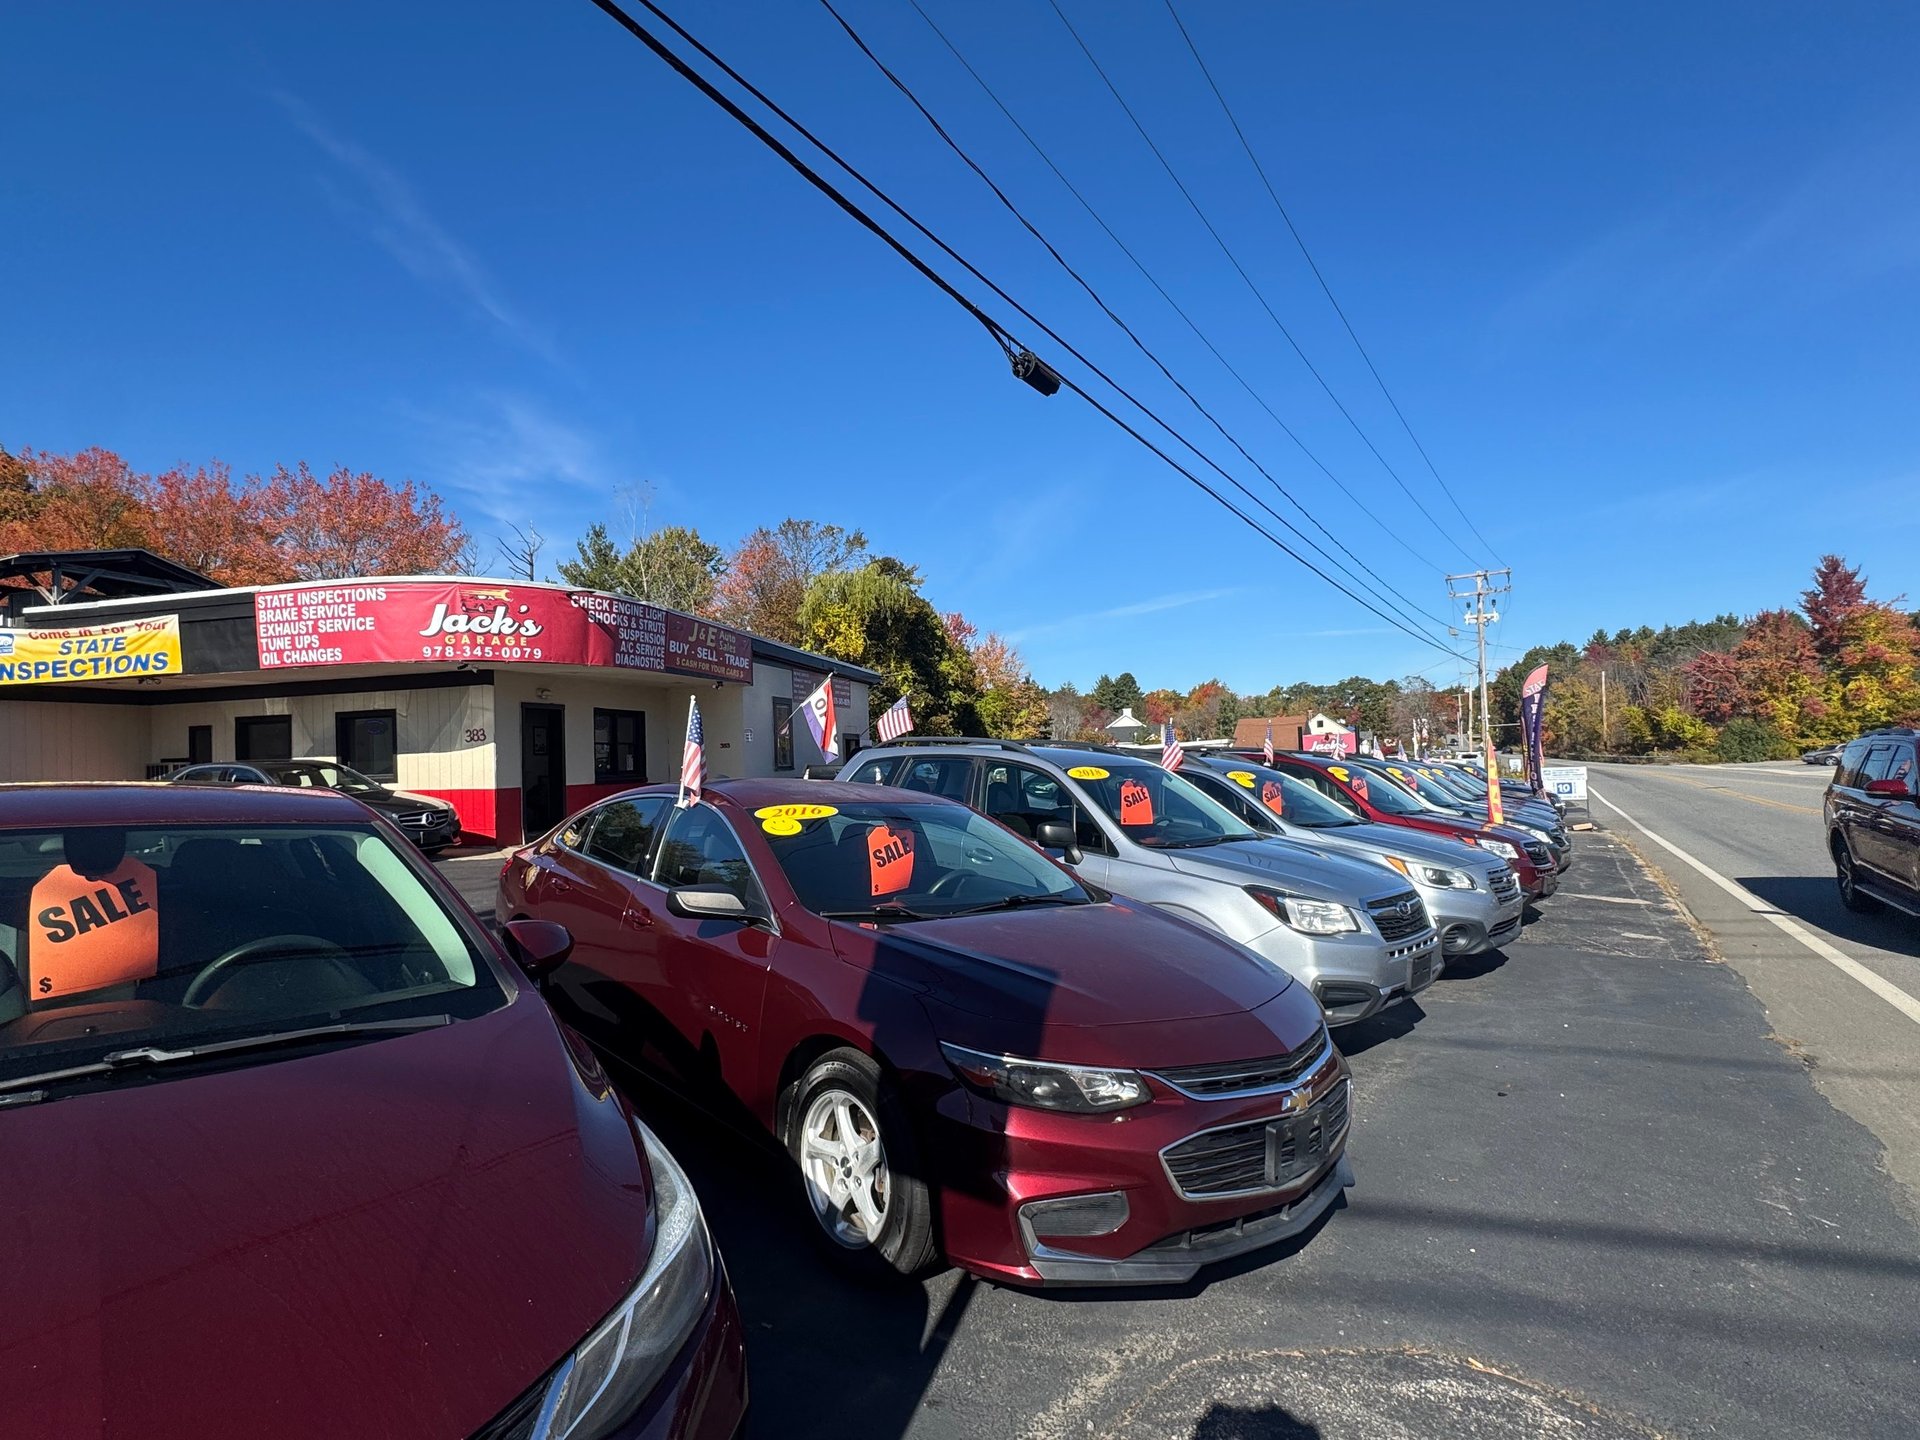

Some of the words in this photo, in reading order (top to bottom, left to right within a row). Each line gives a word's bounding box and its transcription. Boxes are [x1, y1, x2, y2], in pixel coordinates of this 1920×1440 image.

[258, 593, 294, 609] STATE
[298, 587, 387, 606] INSPECTIONS
[259, 608, 298, 623] BRAKE
[302, 603, 356, 619] SERVICE
[571, 595, 610, 611] CHECK
[612, 601, 643, 617] ENGINE
[645, 606, 666, 622] LIGHT
[260, 620, 314, 637] EXHAUST
[318, 617, 375, 633] SERVICE
[419, 602, 543, 637] Jack's
[588, 610, 629, 627] SHOCKS
[631, 617, 637, 629] &
[639, 618, 666, 634] STRUTS
[28, 630, 70, 640] Come
[79, 628, 92, 637] in
[101, 626, 126, 635] For
[135, 621, 168, 632] Your
[618, 628, 665, 646] SUSPENSION
[719, 630, 736, 643] Auto
[58, 636, 127, 655] STATE
[260, 637, 292, 651] TUNE
[295, 634, 320, 649] UPS
[444, 635, 527, 646] GARAGE
[719, 641, 736, 653] Sales
[262, 651, 281, 666] OIL
[283, 648, 342, 663] CHANGES
[422, 646, 542, 659] 978-345-0079
[635, 642, 665, 658] SERVICE
[669, 640, 690, 655] BUY
[697, 647, 718, 662] SELL
[725, 653, 749, 669] TRADE
[0, 652, 169, 681] NSPECTIONS
[615, 653, 665, 670] DIAGNOSTICS
[681, 658, 697, 669] CASH
[698, 662, 710, 671] FOR
[711, 664, 725, 675] YOUR
[726, 667, 739, 677] CARS
[465, 728, 486, 743] 383
[1558, 784, 1570, 793] 10
[1123, 788, 1148, 808] SALE
[772, 807, 822, 818] 2016
[873, 837, 912, 868] SALE
[874, 884, 879, 893] $
[38, 878, 151, 944] SALE
[39, 977, 53, 993] $
